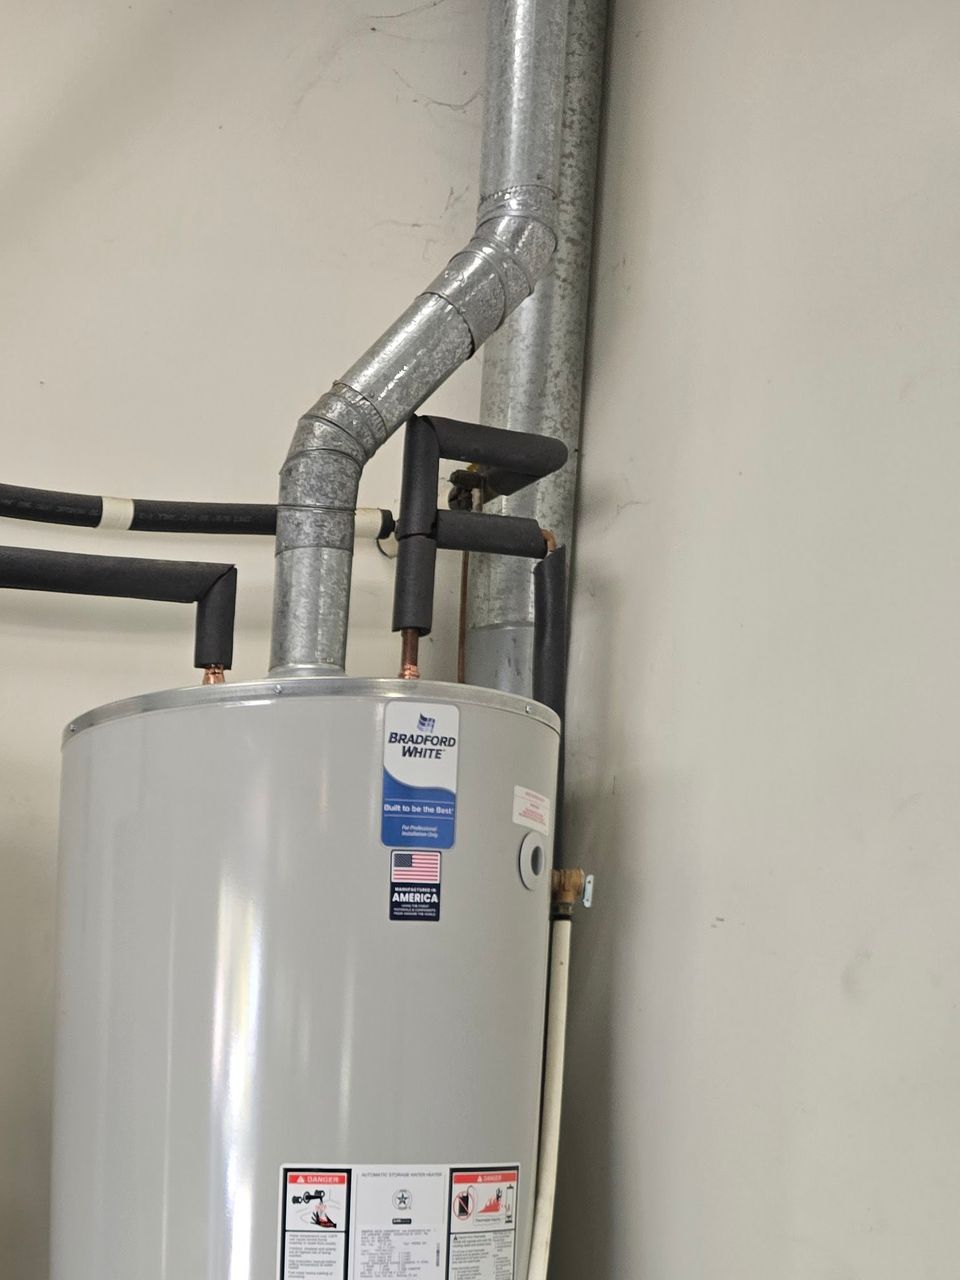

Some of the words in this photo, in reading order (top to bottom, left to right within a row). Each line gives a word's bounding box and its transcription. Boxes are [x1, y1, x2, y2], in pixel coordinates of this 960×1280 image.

[388, 732, 456, 747] BRADFORD
[402, 745, 442, 759] WHITE
[384, 803, 401, 812] Built
[402, 804, 410, 812] to
[411, 804, 421, 812] be
[423, 805, 435, 813] the
[436, 806, 452, 814] Best
[392, 892, 439, 903] AMERICA
[307, 1175, 339, 1183] DANGER
